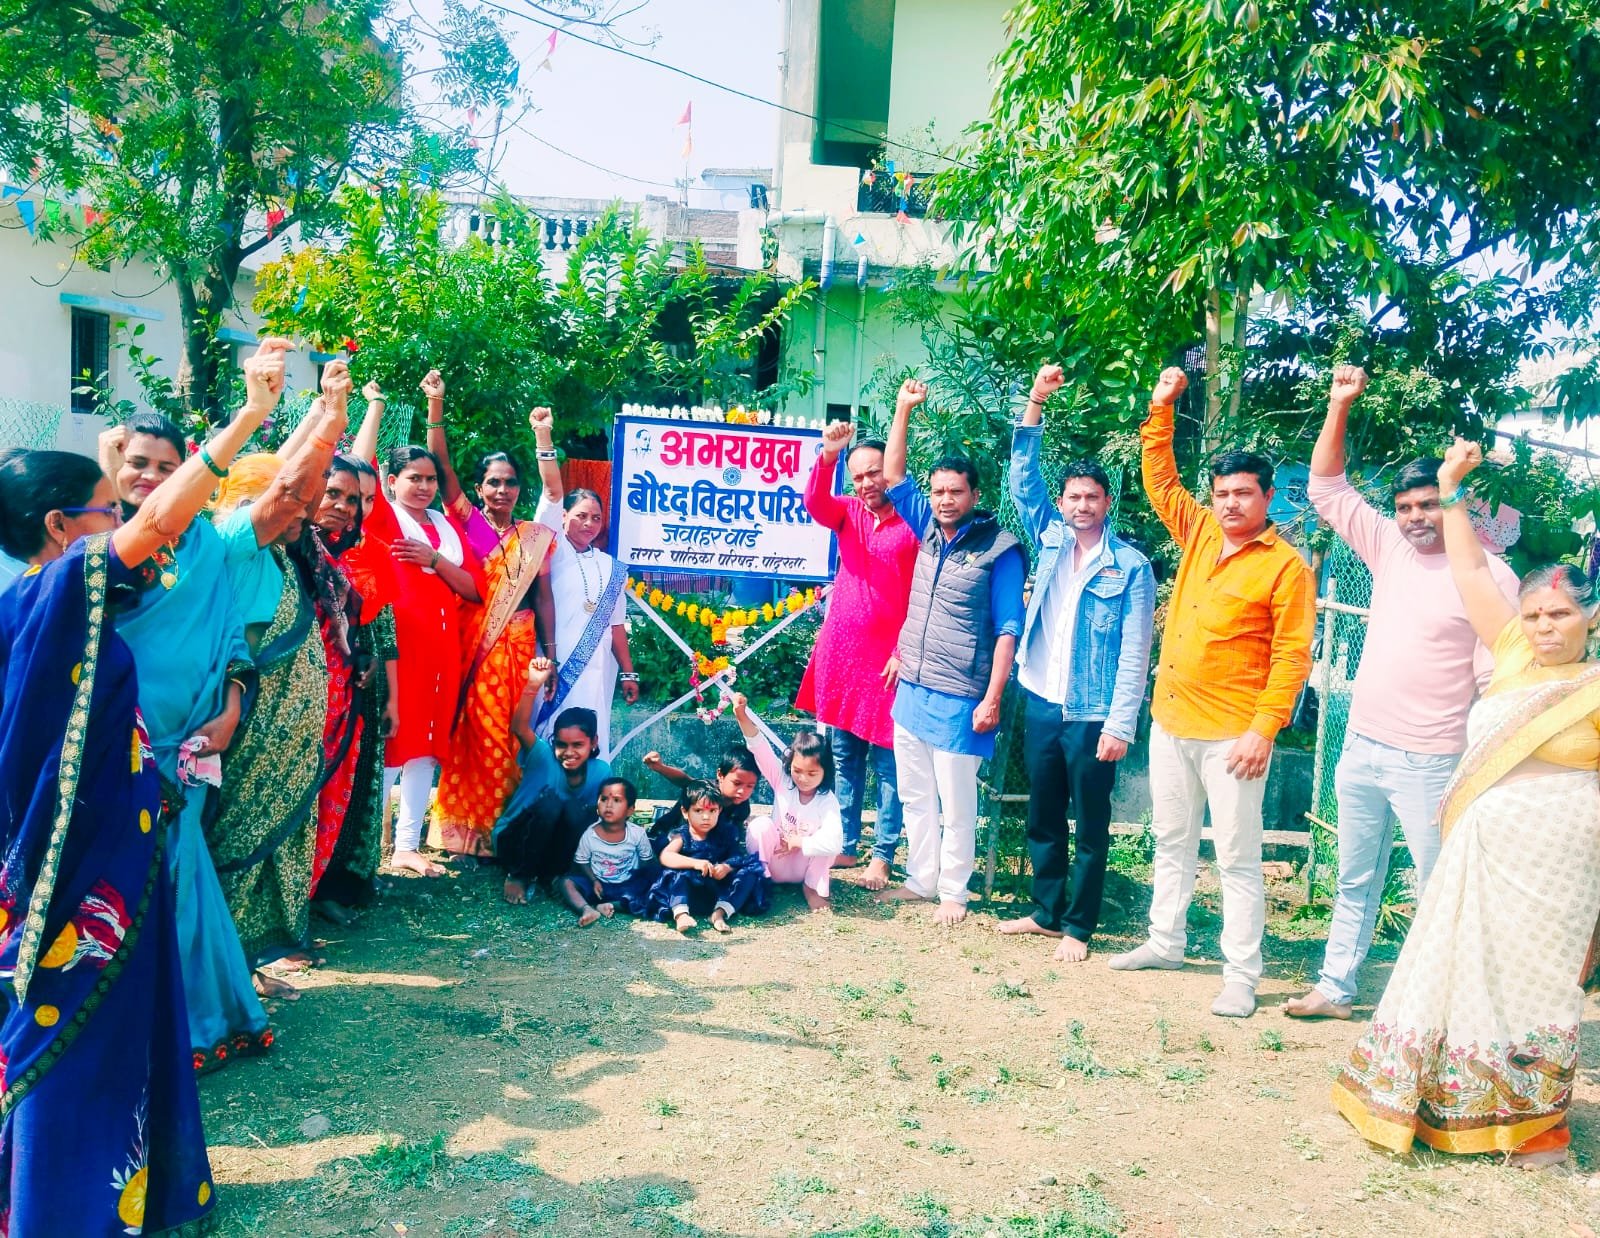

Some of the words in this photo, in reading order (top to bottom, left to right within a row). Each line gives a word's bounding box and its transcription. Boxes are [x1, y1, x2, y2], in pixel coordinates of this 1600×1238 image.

[660, 430, 750, 470] अभय
[750, 437, 802, 484] मुद्रा
[691, 480, 756, 523] विहार
[758, 485, 812, 523] परिस
[662, 523, 728, 547] जवाहर
[724, 523, 763, 548] वार्ड
[630, 547, 664, 562] नगर
[671, 547, 715, 565] पालिका
